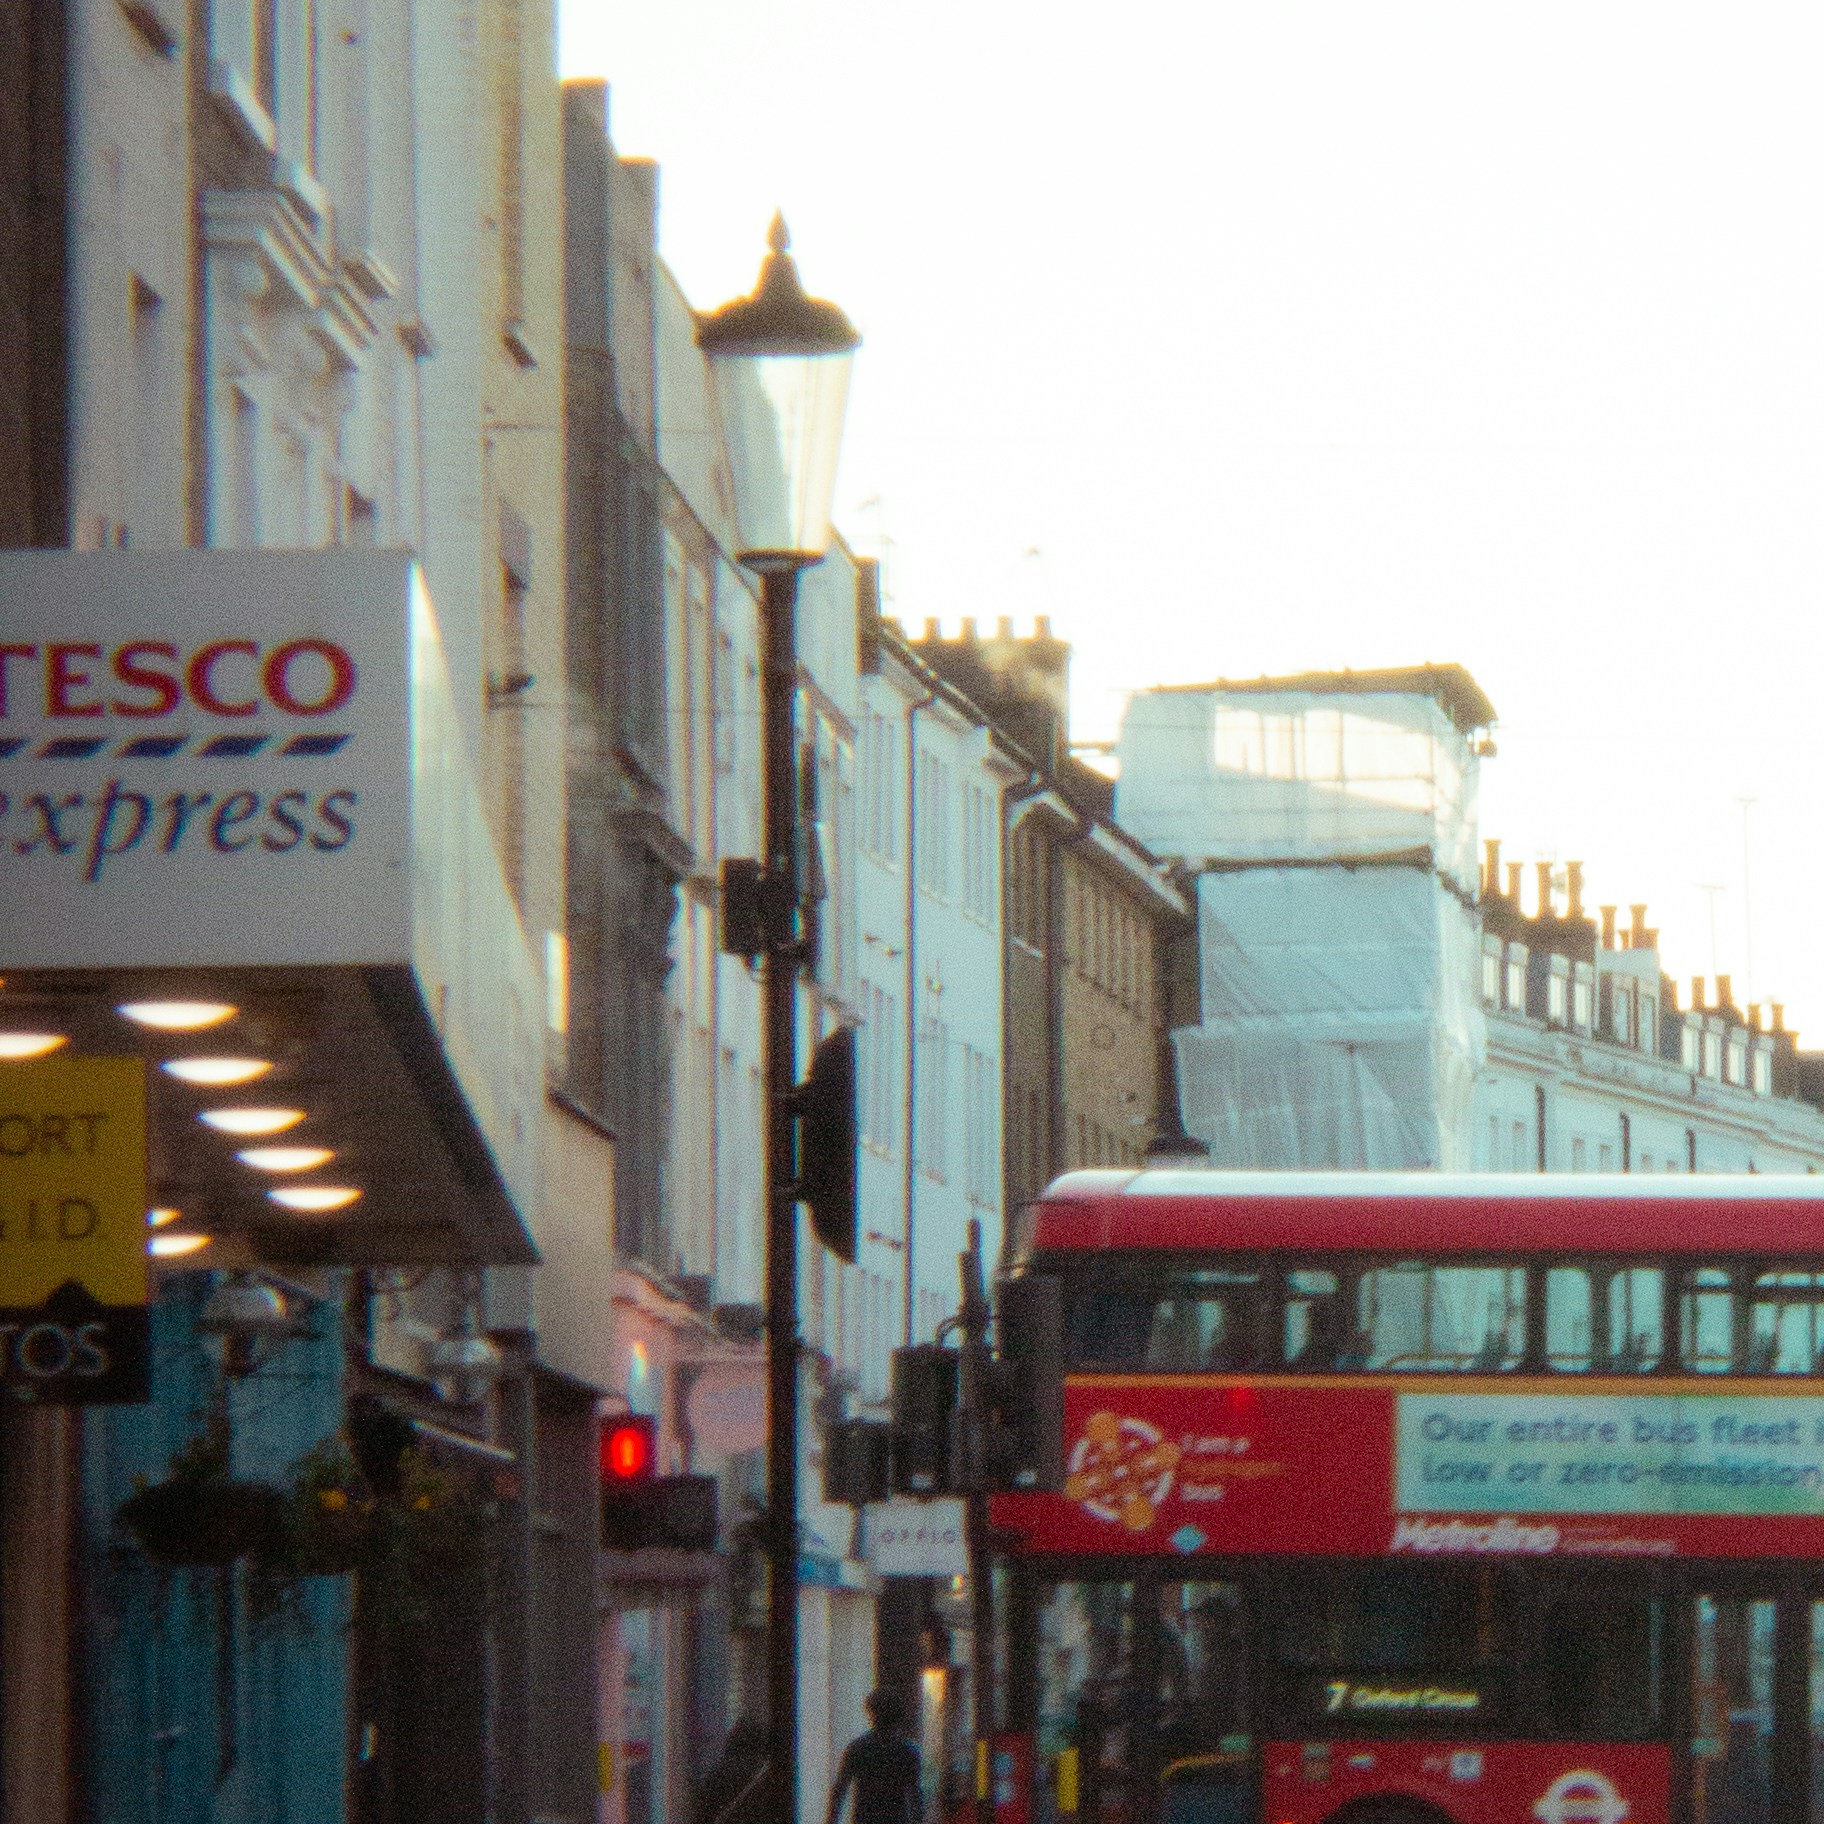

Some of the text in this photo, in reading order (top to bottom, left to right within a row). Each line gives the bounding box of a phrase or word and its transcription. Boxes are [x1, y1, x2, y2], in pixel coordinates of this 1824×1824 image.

[0, 778, 356, 883] xpress
[1422, 1413, 1493, 1444] Our
[1505, 1416, 1617, 1444] entire
[1632, 1414, 1698, 1444] bus
[1711, 1414, 1799, 1446] fleet
[1506, 1461, 1546, 1485] or
[1560, 1456, 1824, 1487] zero-emission
[1326, 1680, 1350, 1713] 7
